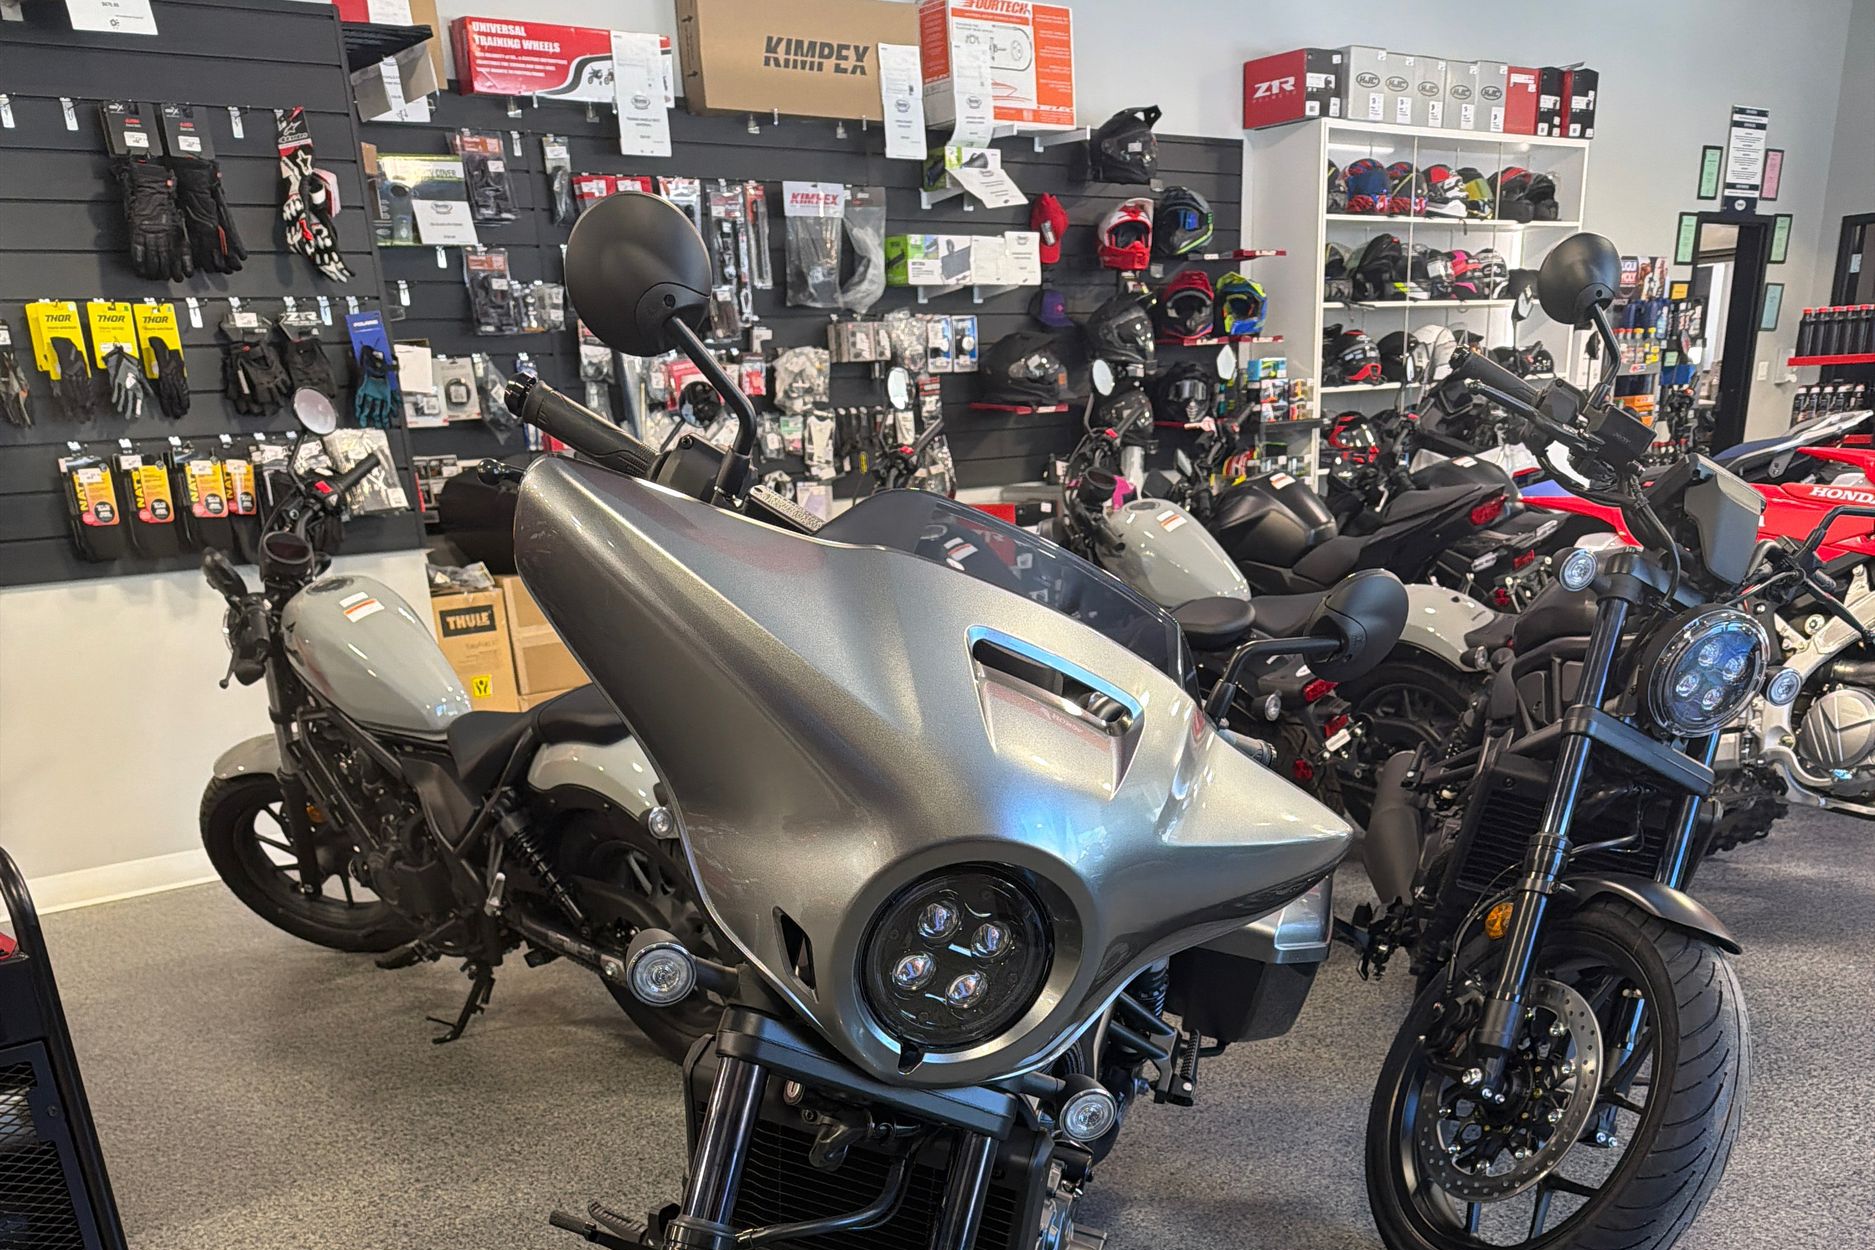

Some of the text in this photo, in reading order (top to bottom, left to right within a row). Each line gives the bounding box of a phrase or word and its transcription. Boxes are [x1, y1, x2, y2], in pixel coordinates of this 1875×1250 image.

[471, 21, 526, 37] UNIVERSAL
[472, 34, 561, 53] TRAINING WHEELS
[763, 35, 871, 76] KIMPEX
[45, 314, 71, 323] THOR
[97, 314, 125, 323] THOR
[142, 315, 169, 324] THOR
[446, 612, 490, 630] THULE
